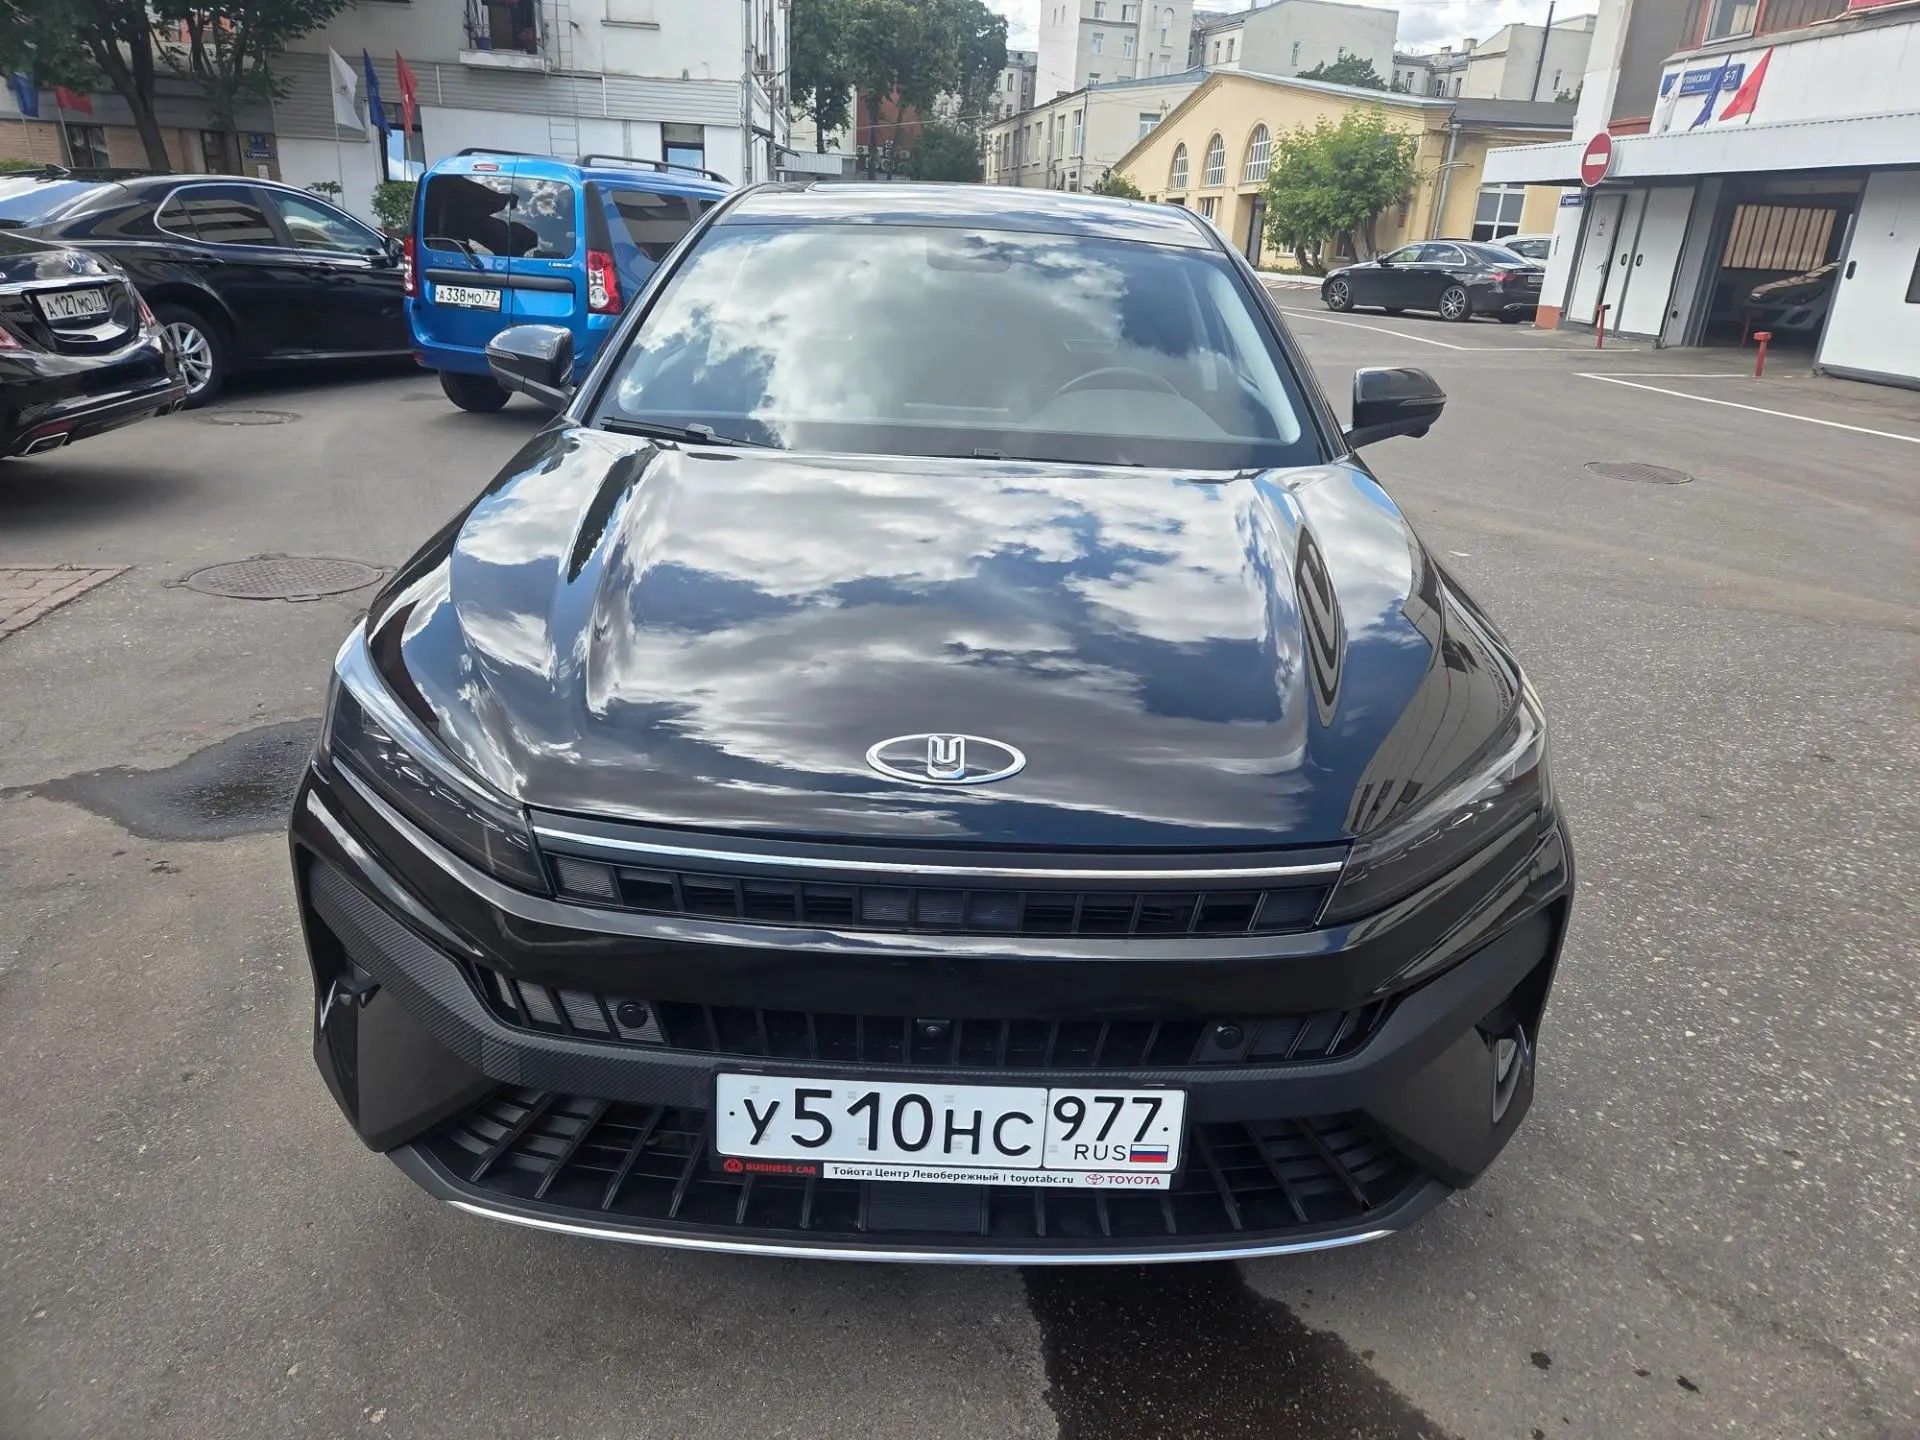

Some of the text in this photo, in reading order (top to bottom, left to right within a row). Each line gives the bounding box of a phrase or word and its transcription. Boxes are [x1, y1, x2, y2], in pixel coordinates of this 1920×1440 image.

[46, 290, 103, 318] А127МО 77
[439, 287, 497, 304] А338МО 77
[743, 1088, 1163, 1157] У510НС 977
[1074, 1144, 1127, 1161] RUS
[746, 1162, 817, 1175] BUSINESS CAR
[833, 1166, 999, 1183] Тойота Центр Левобережный
[1010, 1173, 1074, 1185] toyotabc.ru
[1107, 1175, 1161, 1185] TOYOTA
